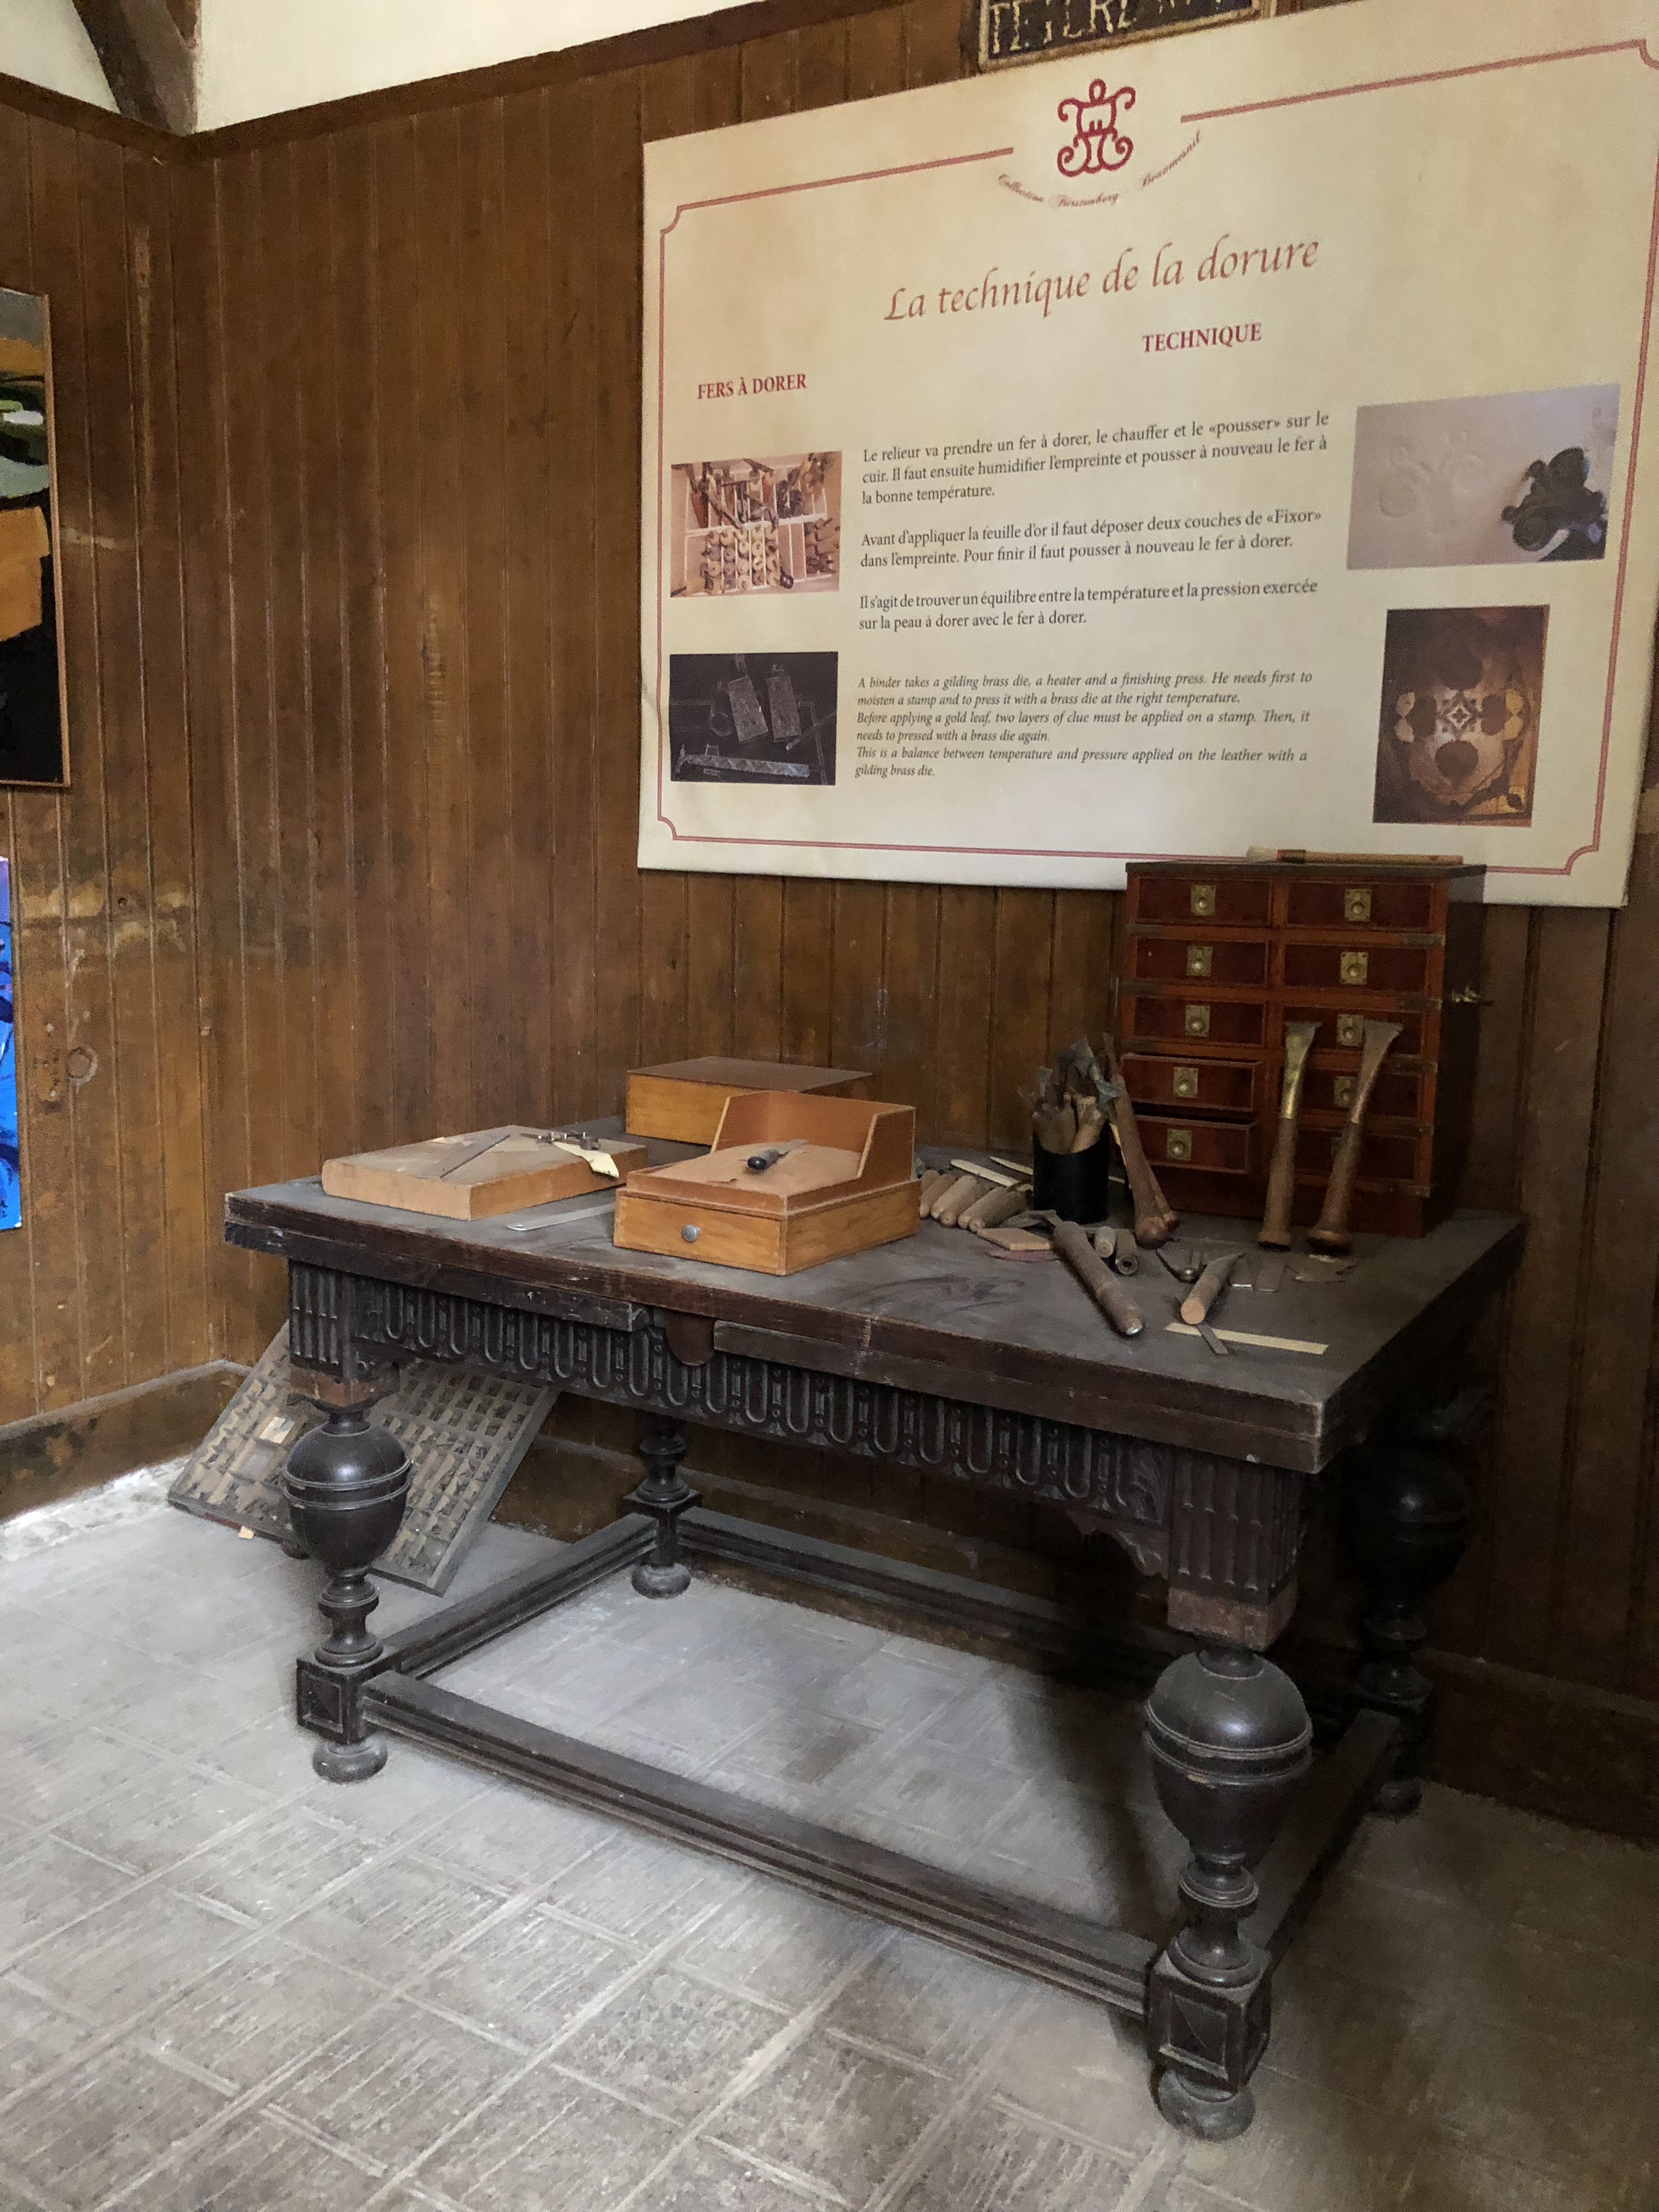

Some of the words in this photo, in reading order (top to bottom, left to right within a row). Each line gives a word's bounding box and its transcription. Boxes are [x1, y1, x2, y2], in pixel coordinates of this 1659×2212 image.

[884, 287, 926, 320] La
[938, 266, 1090, 318] technique
[1102, 247, 1138, 295] de
[1152, 242, 1184, 287] la
[1197, 233, 1319, 282] dorure
[1142, 323, 1262, 353] TECHNIQUE
[698, 381, 733, 399] FERS
[738, 376, 747, 395] À
[753, 374, 806, 394] DORER
[864, 449, 877, 462] Le
[882, 446, 921, 460] relieur
[925, 447, 938, 456] va
[943, 439, 992, 460] prendre
[997, 441, 1013, 452] un
[1019, 435, 1036, 449] fer
[1041, 435, 1047, 448] à
[1052, 432, 1090, 447] dorer,
[1096, 430, 1108, 443] le
[1112, 425, 1169, 442] chauffer
[1173, 425, 1186, 437] et
[1192, 422, 1203, 436] le
[1286, 416, 1310, 428] sur
[1316, 410, 1329, 426] le
[862, 470, 888, 483] cuir.
[893, 467, 900, 481] Il
[904, 466, 926, 479] faut
[930, 464, 974, 478] ensuite
[978, 457, 1045, 475] humidifier
[1125, 452, 1137, 464] et
[1141, 449, 1196, 467] pousser
[1200, 444, 1206, 459] à
[1212, 443, 1272, 458] nouveau
[1278, 437, 1290, 453] le
[1295, 438, 1314, 451] fer
[1319, 435, 1326, 449] à
[862, 490, 871, 504] la
[876, 490, 912, 503] bonne
[917, 485, 994, 503] température.
[861, 534, 895, 546] Avant
[968, 526, 978, 540] la
[983, 524, 1020, 540] feuille
[1051, 522, 1058, 536] il
[1062, 521, 1087, 535] faut
[1091, 519, 1143, 537] déposer
[1147, 516, 1180, 531] deux
[1184, 512, 1241, 528] couches
[1245, 510, 1262, 525] de
[860, 553, 887, 567] dans
[964, 549, 993, 562] Pour
[997, 546, 1024, 560] finir
[1029, 545, 1036, 559] il
[1041, 544, 1064, 558] faut
[1069, 545, 1120, 562] pousser
[1124, 540, 1131, 554] à
[1136, 541, 1194, 554] nouveau
[1199, 536, 1210, 550] le
[1216, 535, 1234, 550] fer
[1238, 534, 1245, 549] à
[1250, 533, 1292, 548] dorer.
[860, 595, 867, 608] Il
[900, 594, 913, 607] de
[916, 596, 960, 606] trouver
[963, 595, 978, 605] un
[980, 589, 1036, 608] équilibre
[1039, 590, 1071, 602] entre
[1074, 586, 1084, 601] la
[1087, 585, 1169, 603] température
[1171, 585, 1183, 597] et
[1187, 582, 1198, 597] la
[1200, 582, 1260, 601] pression
[1263, 578, 1317, 594] exercée
[859, 620, 877, 629] sur
[881, 615, 890, 629] la
[894, 618, 921, 632] peau
[926, 615, 931, 627] à
[935, 613, 969, 627] dorer
[972, 616, 998, 626] avec
[1003, 611, 1013, 625] le
[1017, 611, 1034, 624] fer
[1038, 611, 1044, 624] à
[1048, 610, 1086, 623] dorer.
[858, 678, 865, 688] A
[869, 676, 901, 688] binder
[905, 675, 929, 687] takes
[942, 675, 979, 691] gilding
[982, 675, 1008, 686] brass
[1012, 674, 1030, 687] die,
[1035, 678, 1042, 686] a
[1046, 673, 1081, 686] heater
[1085, 673, 1107, 685] and
[1110, 676, 1118, 685] a
[1120, 672, 1171, 688] finishing
[1173, 675, 1205, 687] press.
[1211, 672, 1228, 684] He
[1233, 670, 1266, 684] needs
[1269, 670, 1295, 686] first
[1300, 672, 1312, 682] to
[857, 696, 894, 705] moisten
[897, 697, 904, 705] a
[906, 696, 936, 709] stamp
[939, 693, 959, 704] and
[962, 695, 972, 705] to
[973, 696, 1000, 708] press
[1003, 693, 1011, 704] it
[1014, 692, 1037, 704] with
[1050, 692, 1078, 704] brass
[1081, 691, 1098, 704] die
[1101, 694, 1112, 704] at
[1115, 691, 1132, 703] the
[1136, 691, 1163, 707] right
[1166, 692, 1239, 707] temperature.
[857, 712, 887, 726] Before
[890, 711, 932, 726] applying
[944, 711, 967, 726] gold
[970, 710, 991, 726] leaf,
[995, 713, 1014, 723] two
[1018, 710, 1049, 726] layers
[1053, 710, 1065, 726] of
[1066, 710, 1089, 723] clue
[1093, 713, 1121, 723] must
[1125, 710, 1137, 723] be
[1141, 710, 1183, 726] applied
[1187, 713, 1201, 722] on
[1206, 713, 1214, 722] a
[1218, 712, 1256, 726] stamp.
[1263, 709, 1295, 723] Then,
[1301, 710, 1310, 721] it
[856, 729, 883, 740] needs
[885, 731, 895, 741] to
[897, 729, 933, 744] pressed
[936, 729, 958, 741] with
[961, 732, 967, 740] a
[970, 729, 996, 741] brass
[999, 729, 1015, 741] die
[1018, 730, 1049, 744] again.
[854, 764, 888, 778] gilding
[890, 764, 915, 775] brass
[917, 764, 934, 776] die.
